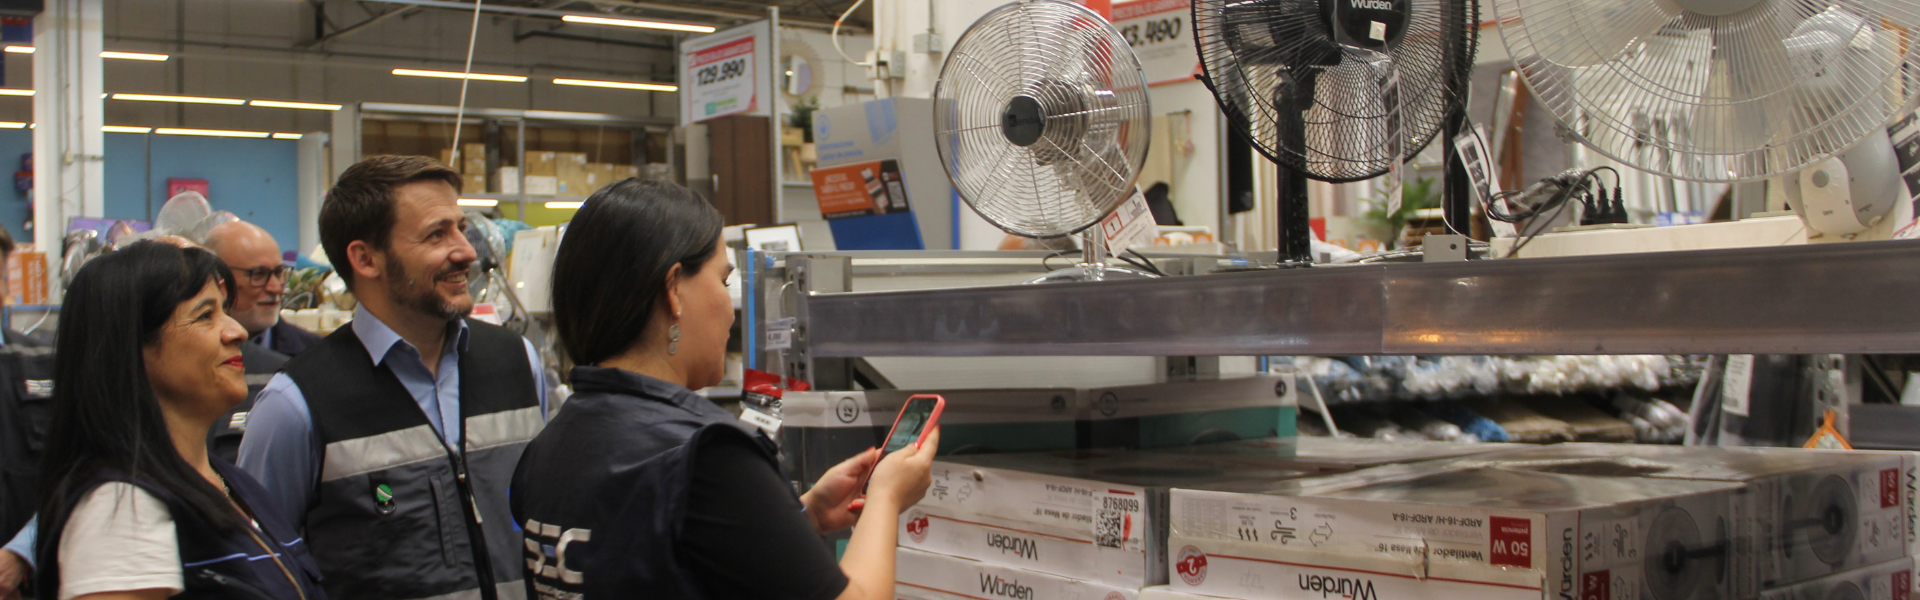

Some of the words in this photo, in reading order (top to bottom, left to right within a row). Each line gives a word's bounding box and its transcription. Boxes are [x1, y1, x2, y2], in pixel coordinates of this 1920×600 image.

[697, 58, 746, 86] 129.990
[1103, 496, 1139, 512] 8768099
[1071, 512, 1093, 523] tilador
[1290, 507, 1297, 520] 3
[1392, 512, 1434, 524] ARDF-16-A
[1435, 517, 1482, 527] ARDF-16-H/
[525, 518, 592, 585] SEC
[1391, 544, 1411, 554] Mesa
[1433, 547, 1484, 562] Ventilador
[1492, 539, 1507, 555] W
[1510, 540, 1529, 556] 50
